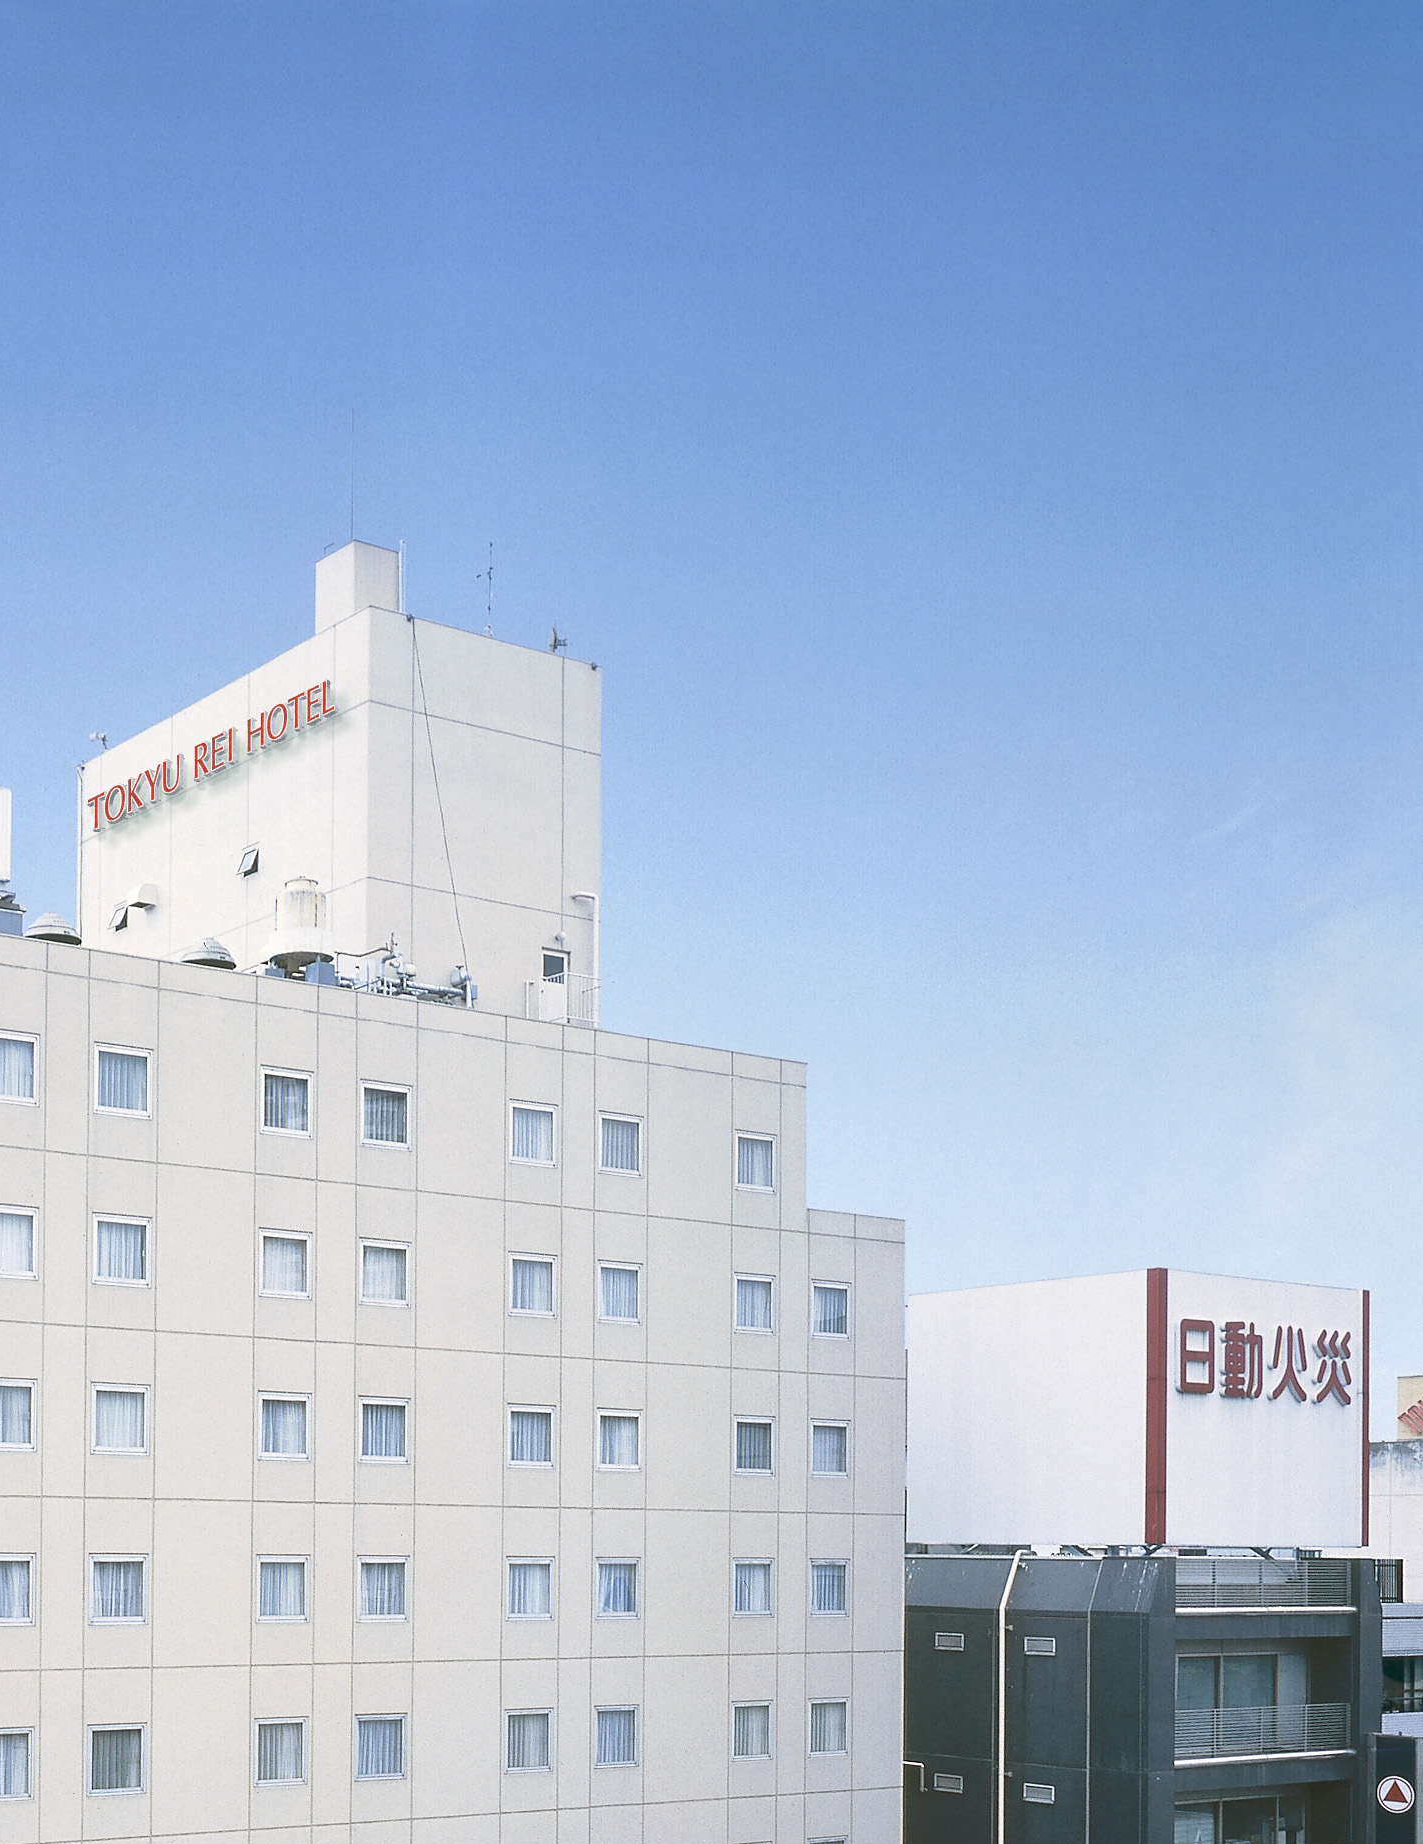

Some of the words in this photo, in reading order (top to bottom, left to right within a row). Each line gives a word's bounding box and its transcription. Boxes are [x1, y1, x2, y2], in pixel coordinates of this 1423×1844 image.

[87, 753, 185, 832] TOKYU
[193, 726, 238, 783] REI
[246, 679, 338, 755] HOTEL
[1179, 1317, 1352, 1407] 日動火災
